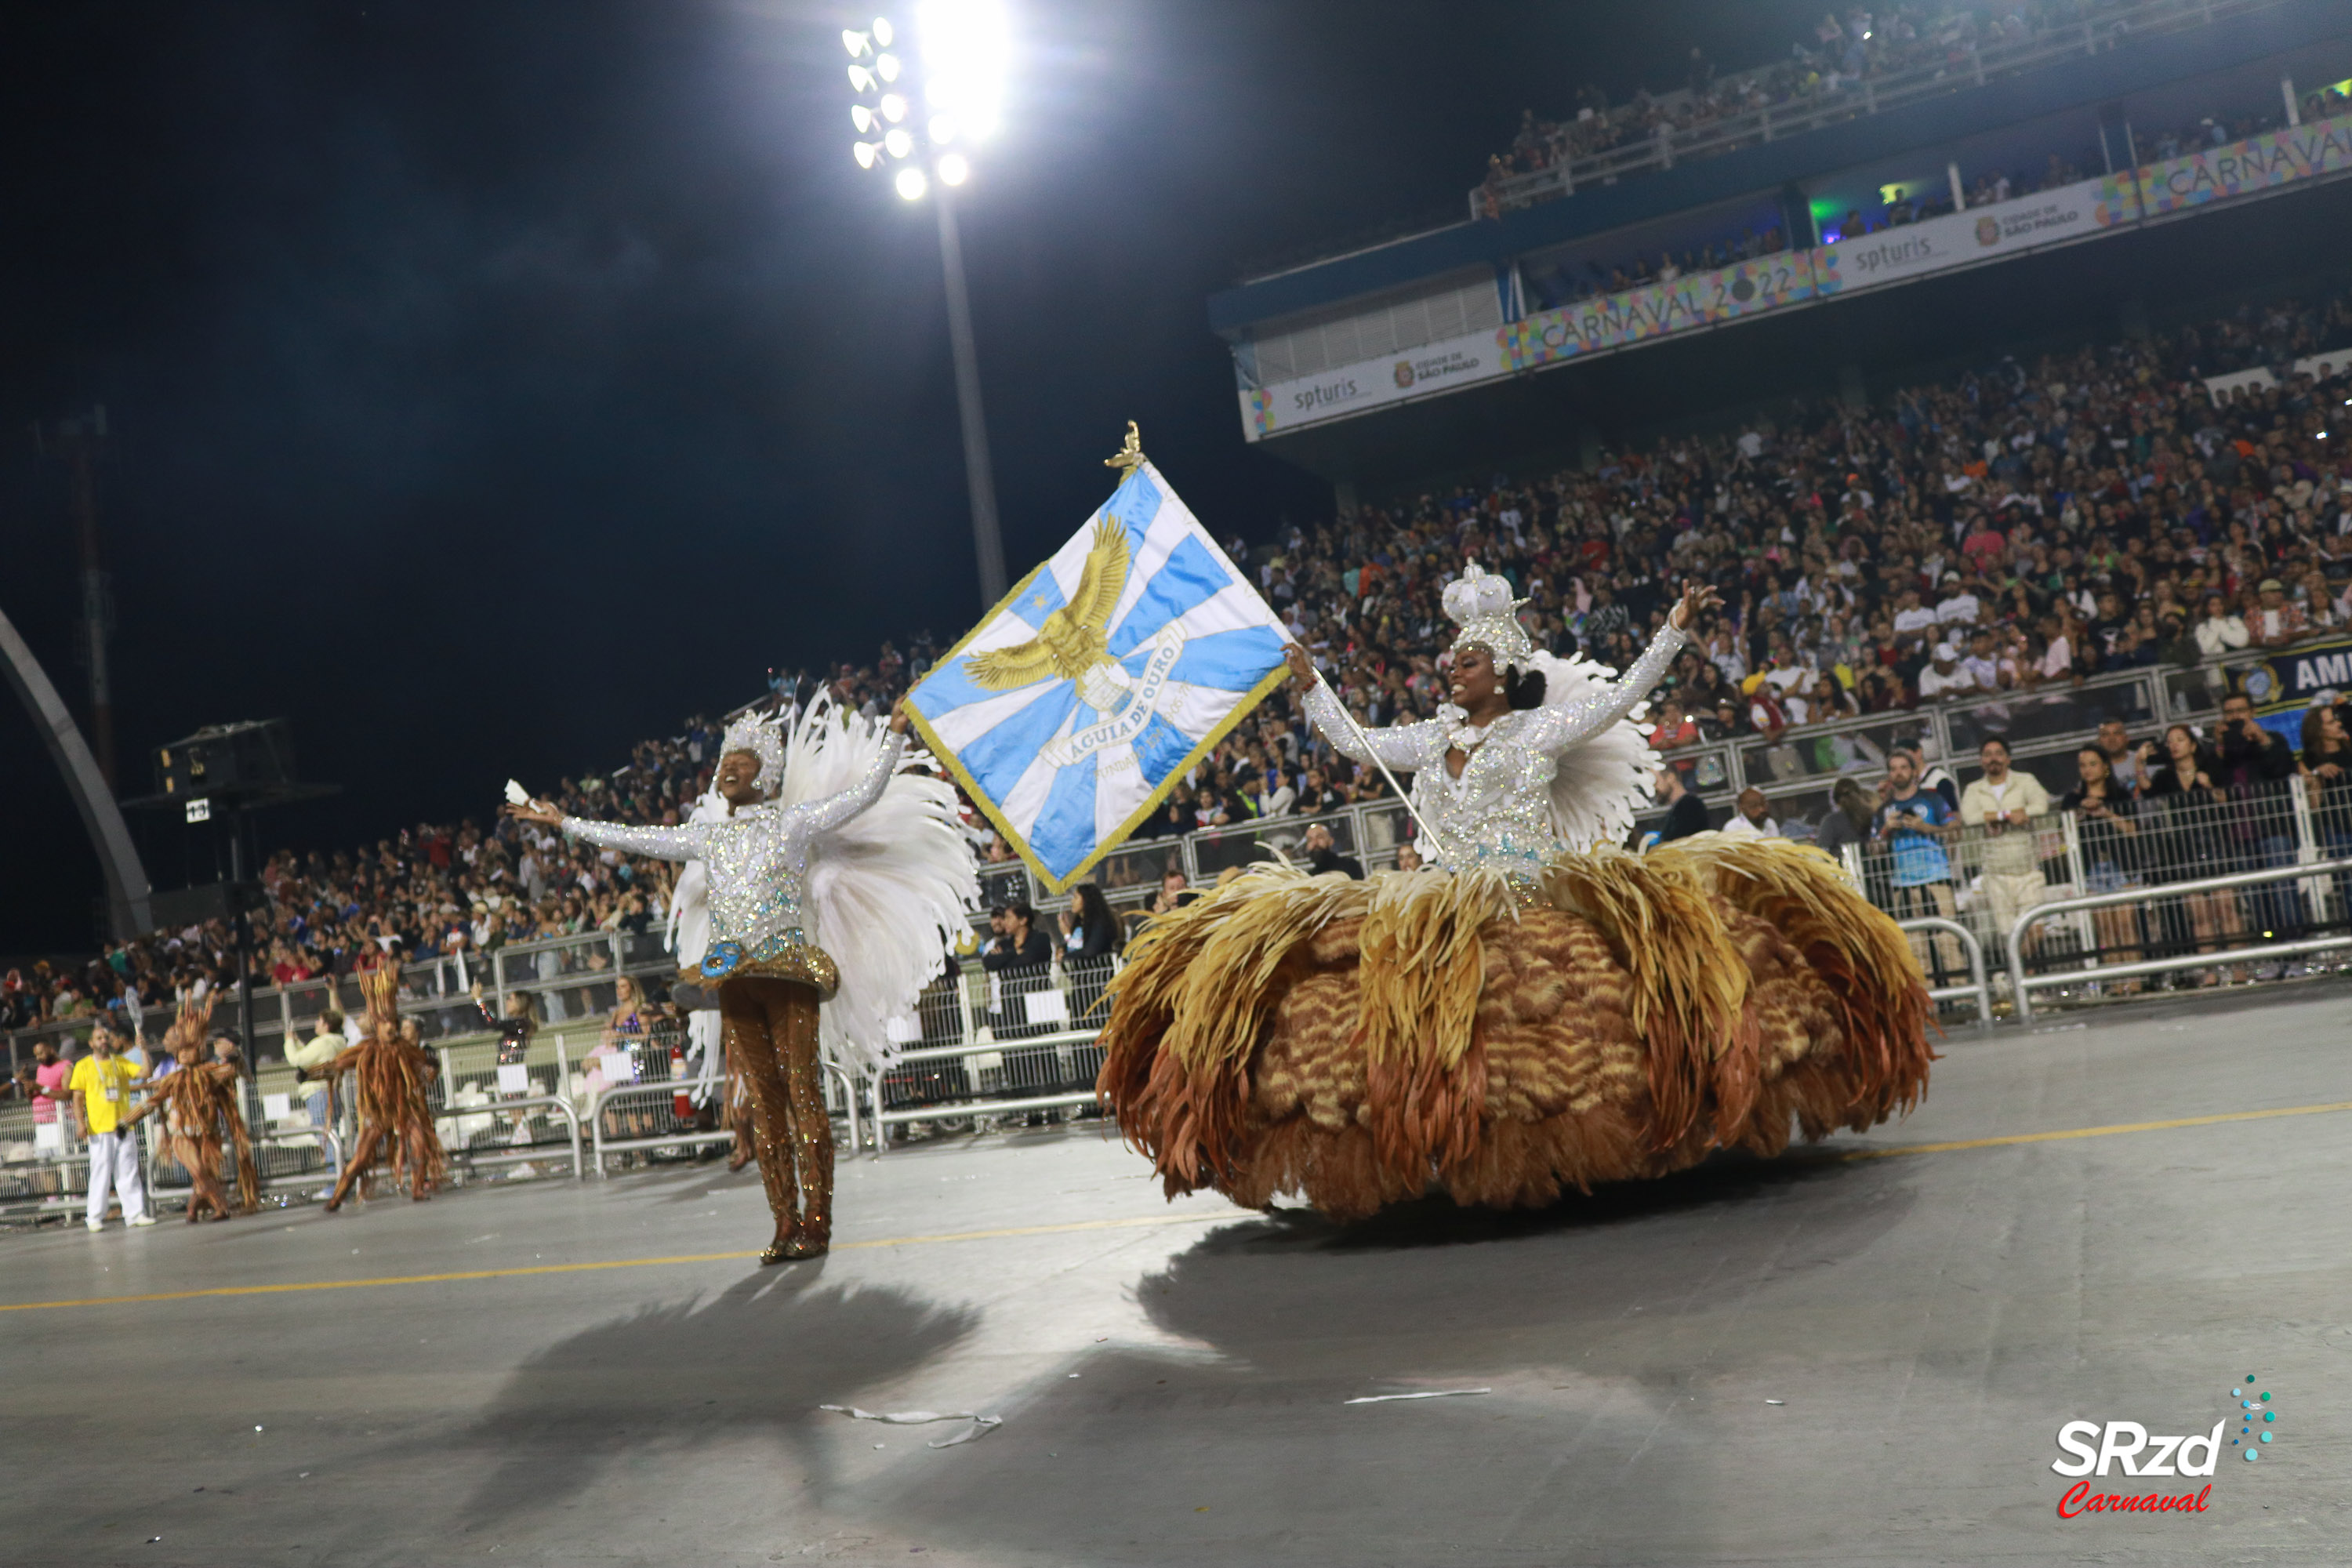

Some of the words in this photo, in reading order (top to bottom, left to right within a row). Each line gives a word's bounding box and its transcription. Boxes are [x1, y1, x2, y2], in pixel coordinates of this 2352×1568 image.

[2035, 211, 2078, 229] PAULO
[1856, 236, 1932, 271] spturis
[1542, 292, 1703, 348] CARNAVAL
[1443, 358, 1480, 374] PAULO
[1294, 379, 1357, 411] spturis
[1072, 721, 1132, 758] AGUIA
[1129, 700, 1149, 727] DE
[1142, 647, 1174, 699] OURO
[1094, 747, 1147, 779] FUNDADO
[1146, 728, 1164, 750] EM
